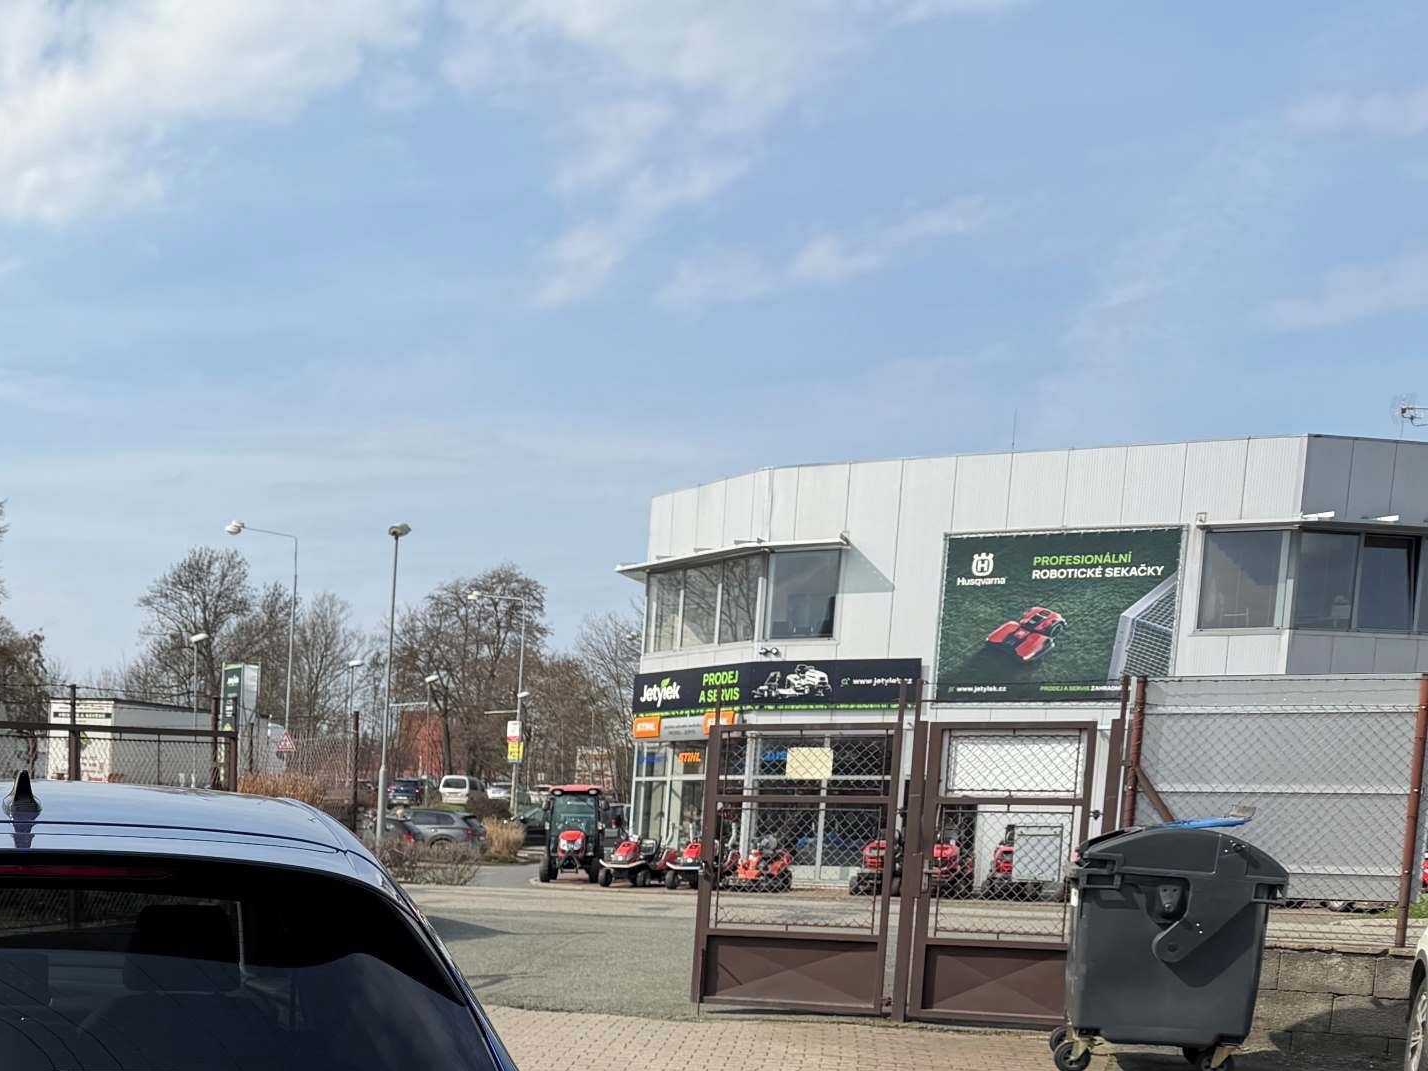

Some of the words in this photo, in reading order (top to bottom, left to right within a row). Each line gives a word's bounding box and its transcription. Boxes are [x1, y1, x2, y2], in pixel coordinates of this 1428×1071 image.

[1033, 551, 1133, 566] PROFESIONÁLNÍ
[1032, 566, 1103, 580] ROBOTICKÉ
[1104, 563, 1165, 578] SEKAČKY
[956, 576, 1006, 587] Husqvarna
[702, 670, 739, 687] PRODEJ
[698, 690, 706, 703] A
[678, 751, 701, 763] STIHL
